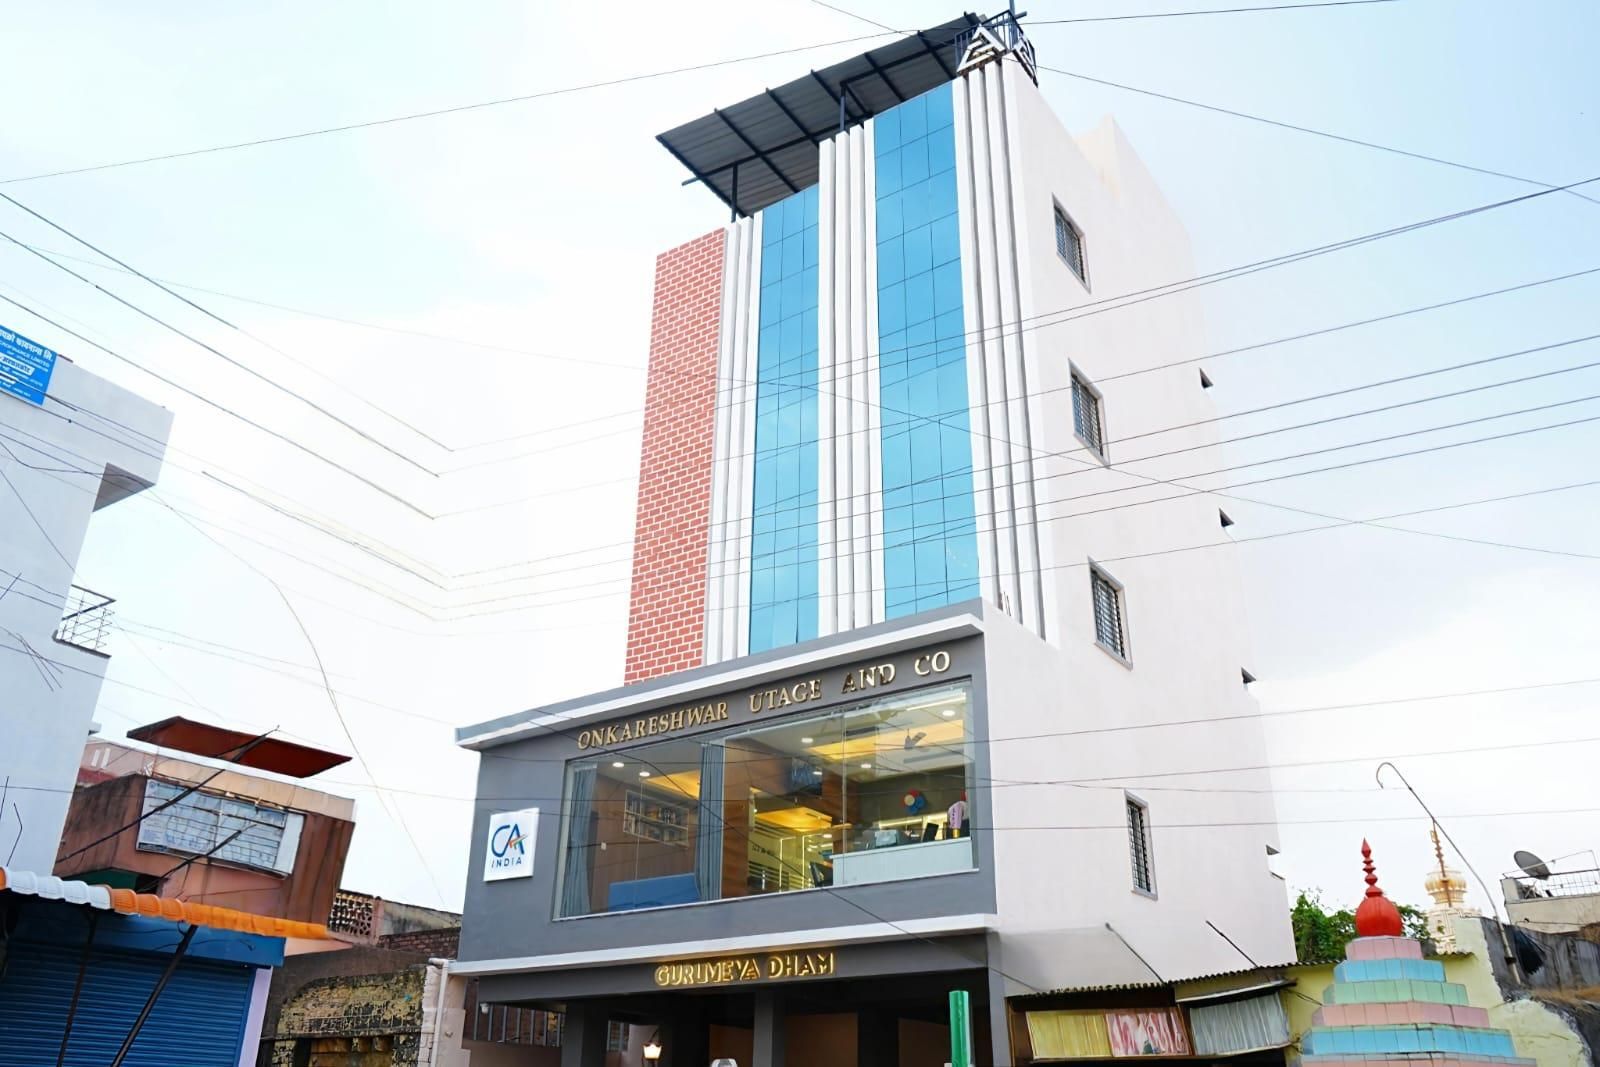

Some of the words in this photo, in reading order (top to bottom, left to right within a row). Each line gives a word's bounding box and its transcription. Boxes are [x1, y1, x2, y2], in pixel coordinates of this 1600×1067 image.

[577, 702, 728, 750] ONKARESHWAR
[749, 679, 822, 713] UTAGE
[841, 663, 896, 694] AND
[914, 651, 950, 676] CO
[491, 824, 526, 857] CA
[491, 857, 522, 868] INDIA
[768, 952, 835, 979] DHAM
